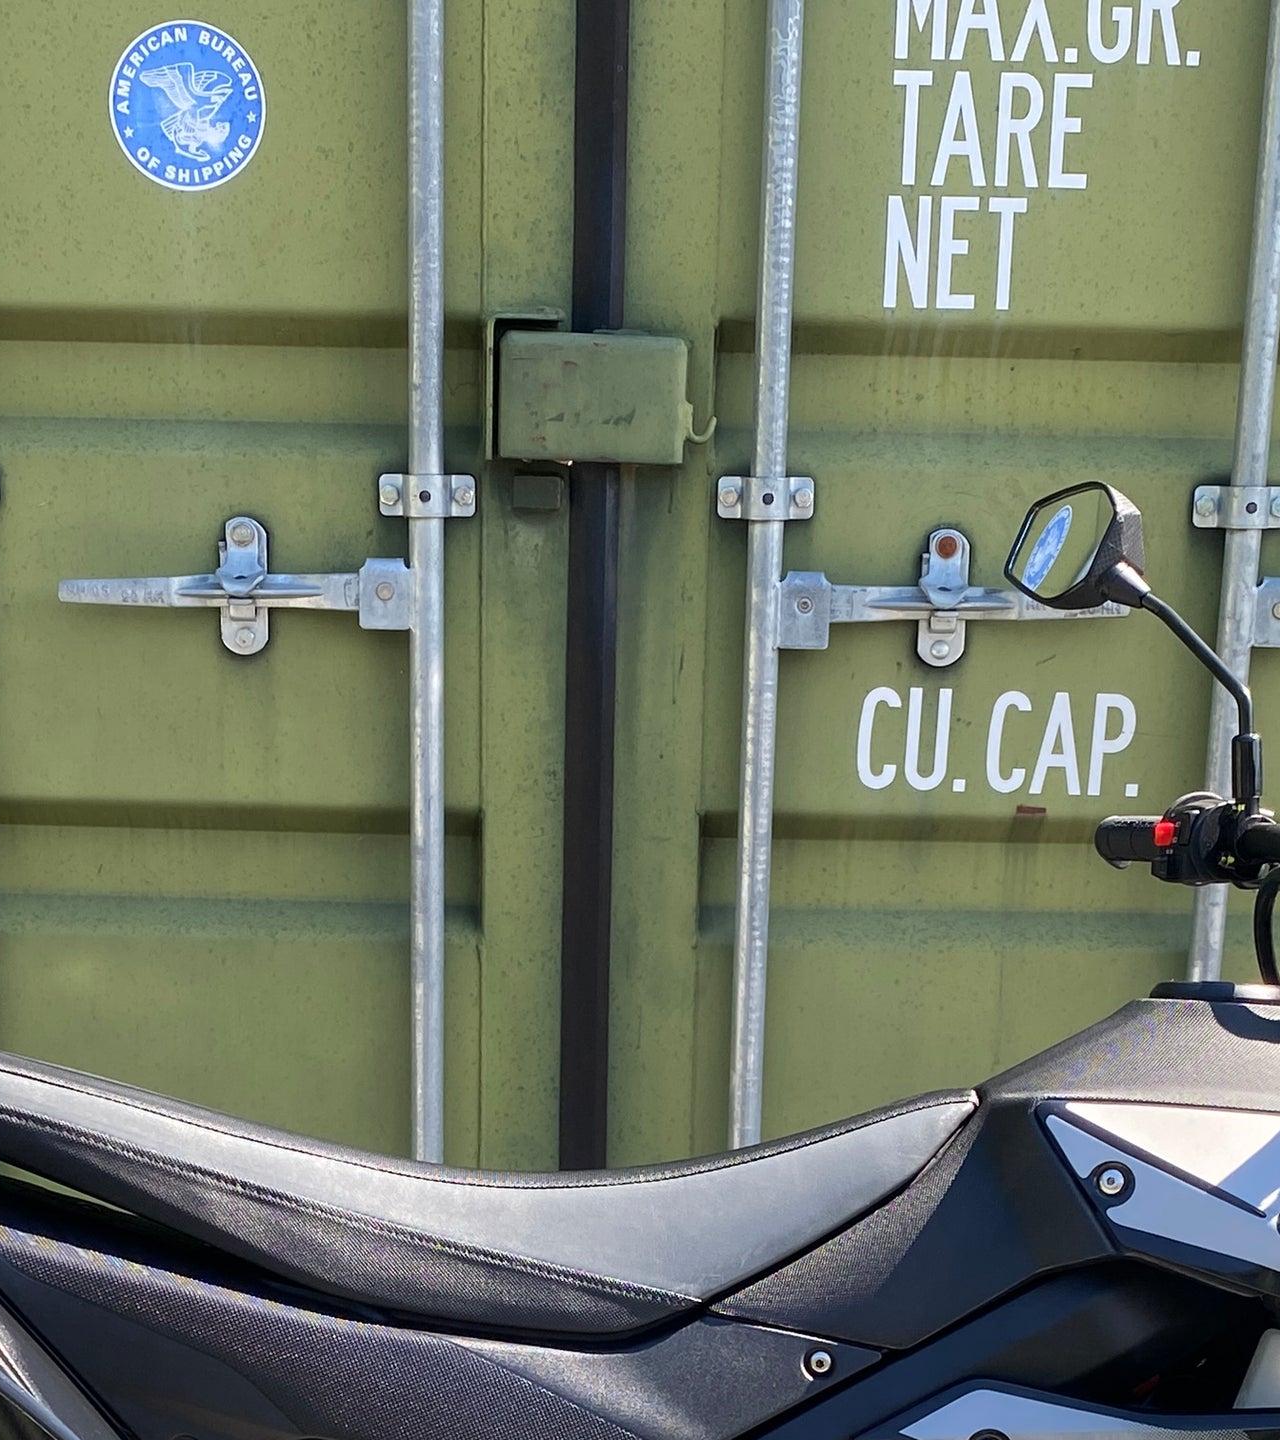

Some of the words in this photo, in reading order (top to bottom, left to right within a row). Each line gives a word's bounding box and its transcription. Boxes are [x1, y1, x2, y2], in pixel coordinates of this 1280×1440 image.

[116, 27, 188, 115] AMERICAN
[198, 30, 258, 101] BUREAU
[135, 146, 161, 171] OF
[164, 133, 253, 184] SHIPPING
[893, 69, 1094, 190] TARE
[882, 194, 1028, 311] NET
[856, 686, 966, 793] CU.
[985, 690, 1140, 798] CAP.
